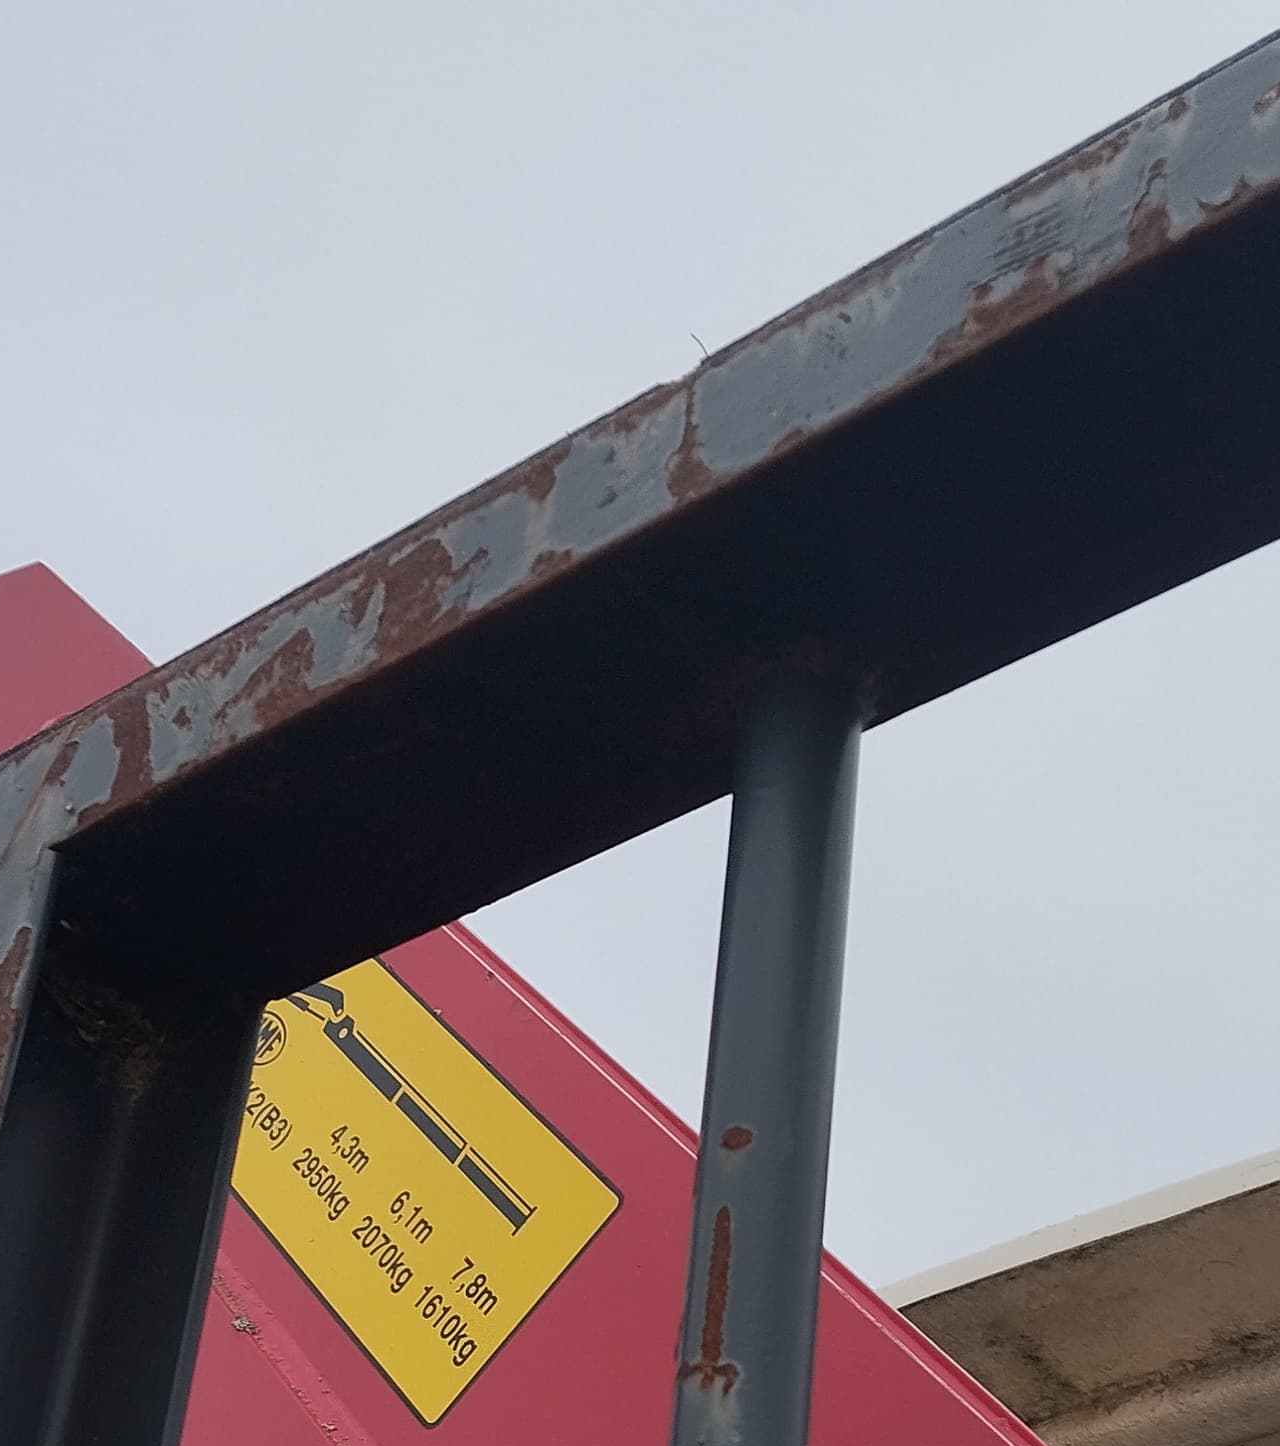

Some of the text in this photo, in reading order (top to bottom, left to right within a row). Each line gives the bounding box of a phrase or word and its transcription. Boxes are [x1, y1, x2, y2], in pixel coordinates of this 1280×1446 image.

[292, 1147, 351, 1222] 2950kg
[352, 1215, 414, 1294] 2070kg
[414, 1285, 478, 1368] 1610kg
[330, 1124, 498, 1316] 4,3m 6,1m 7,8m
